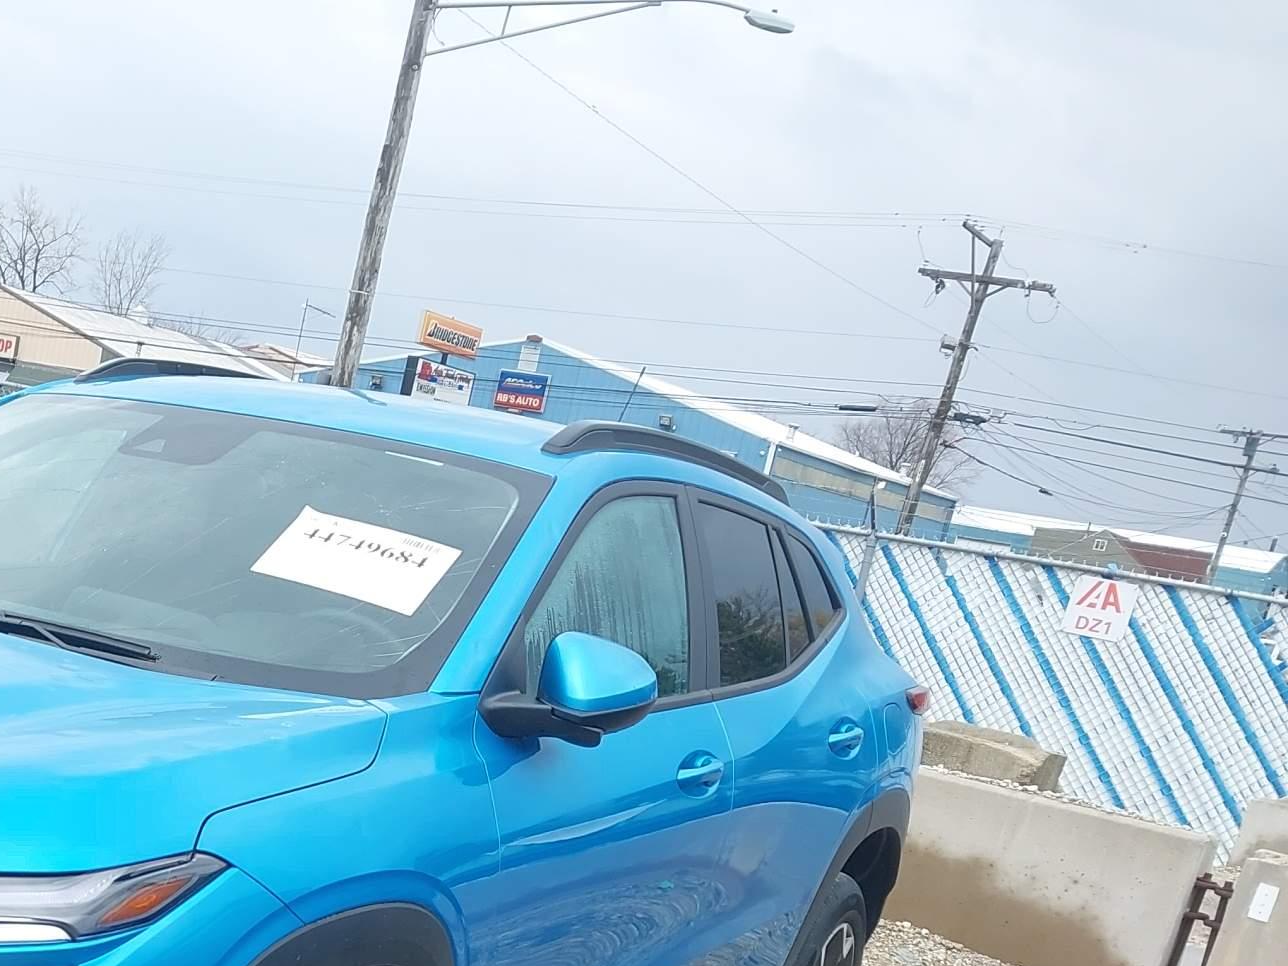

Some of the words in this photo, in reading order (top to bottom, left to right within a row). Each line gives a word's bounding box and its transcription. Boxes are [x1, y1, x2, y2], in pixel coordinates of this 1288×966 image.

[426, 322, 479, 351] BRIDGESTONE
[515, 396, 540, 407] AUTO
[303, 528, 429, 569] 44749684
[1075, 615, 1113, 635] DZ1
